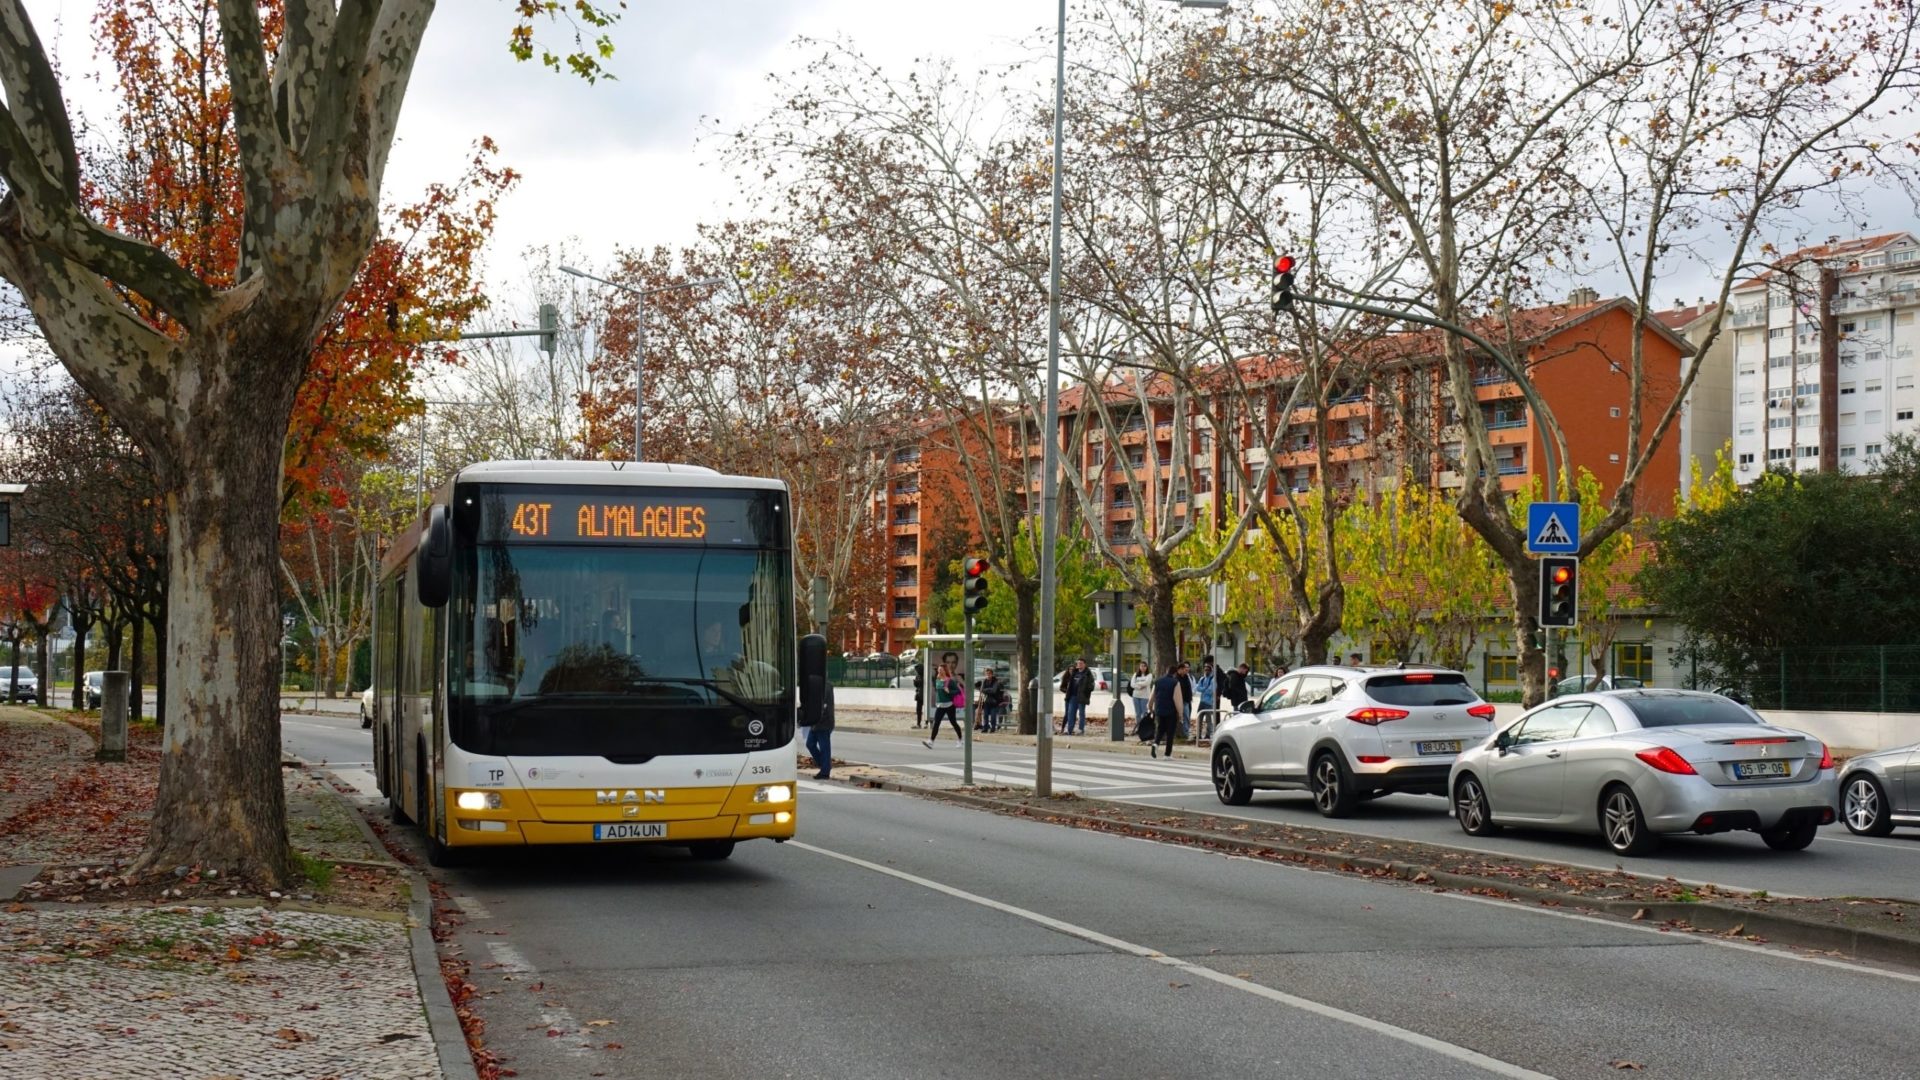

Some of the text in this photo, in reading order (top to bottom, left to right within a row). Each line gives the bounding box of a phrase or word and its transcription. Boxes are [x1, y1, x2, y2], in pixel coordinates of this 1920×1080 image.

[512, 503, 706, 537] 43T ALMALAGUES
[489, 770, 504, 781] TP
[752, 766, 771, 774] 336
[596, 790, 665, 803] MAN
